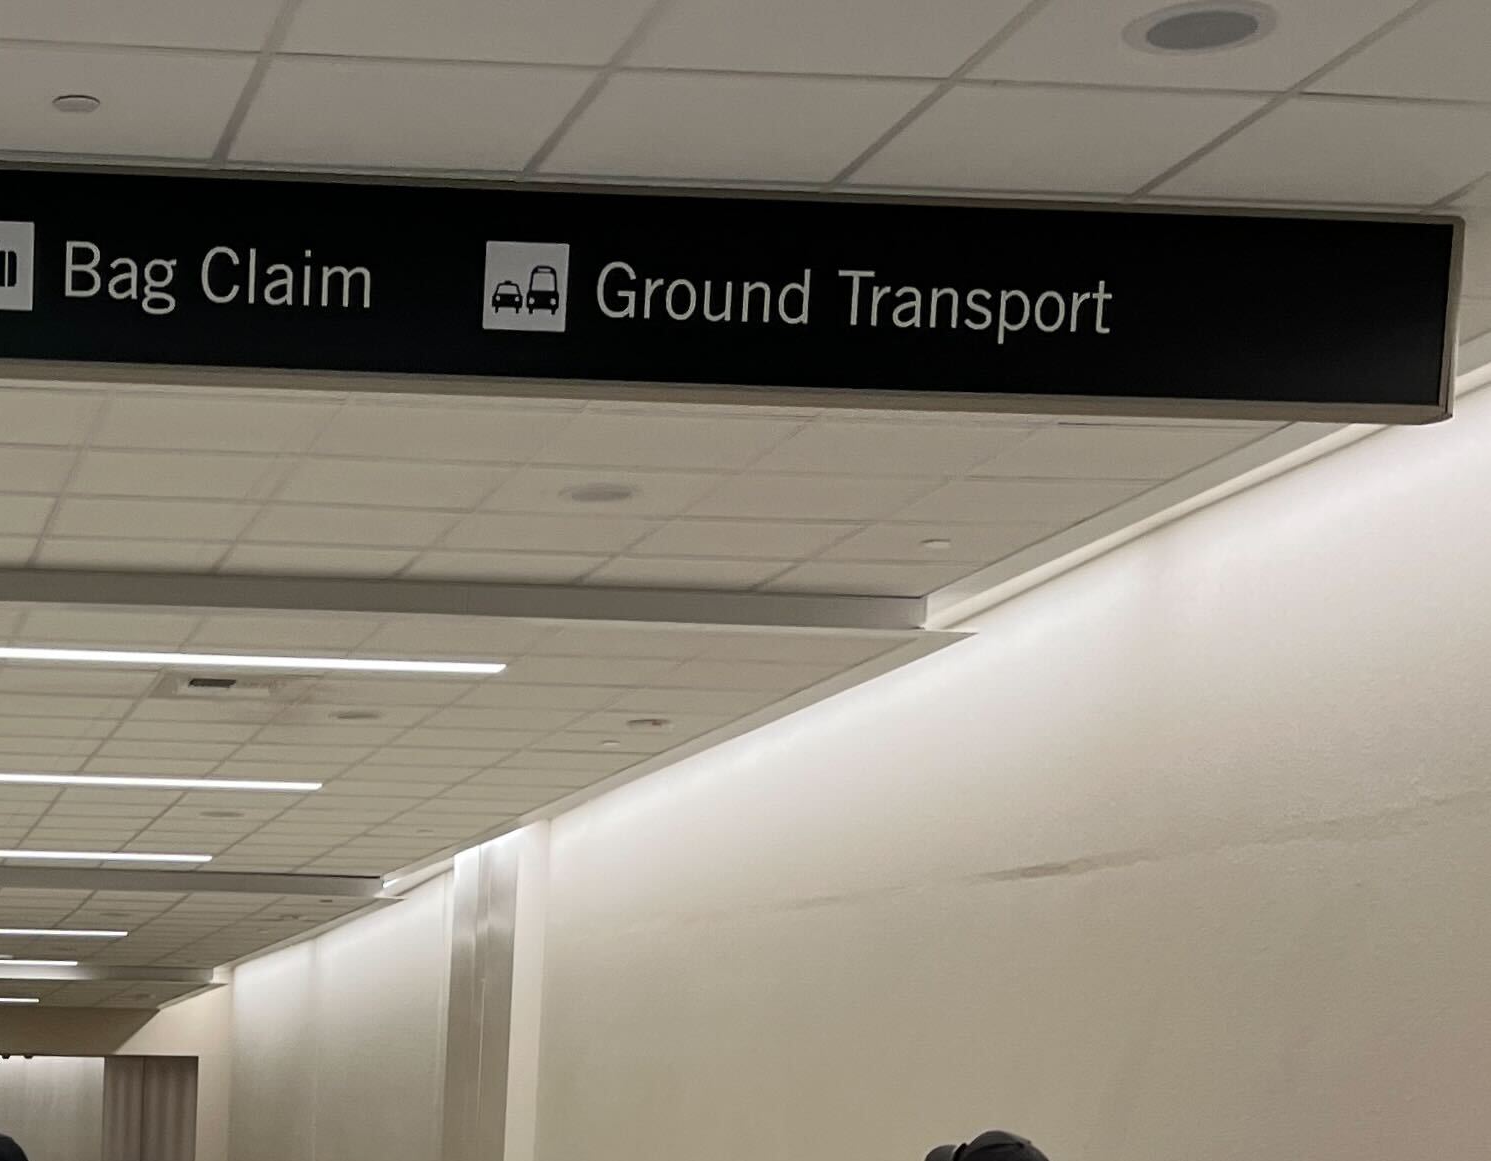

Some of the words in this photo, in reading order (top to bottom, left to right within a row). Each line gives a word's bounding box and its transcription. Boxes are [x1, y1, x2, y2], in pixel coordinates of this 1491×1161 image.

[65, 240, 177, 314] Bag
[201, 246, 371, 308] Claim
[597, 261, 811, 324] Ground
[838, 269, 1112, 344] Transport
